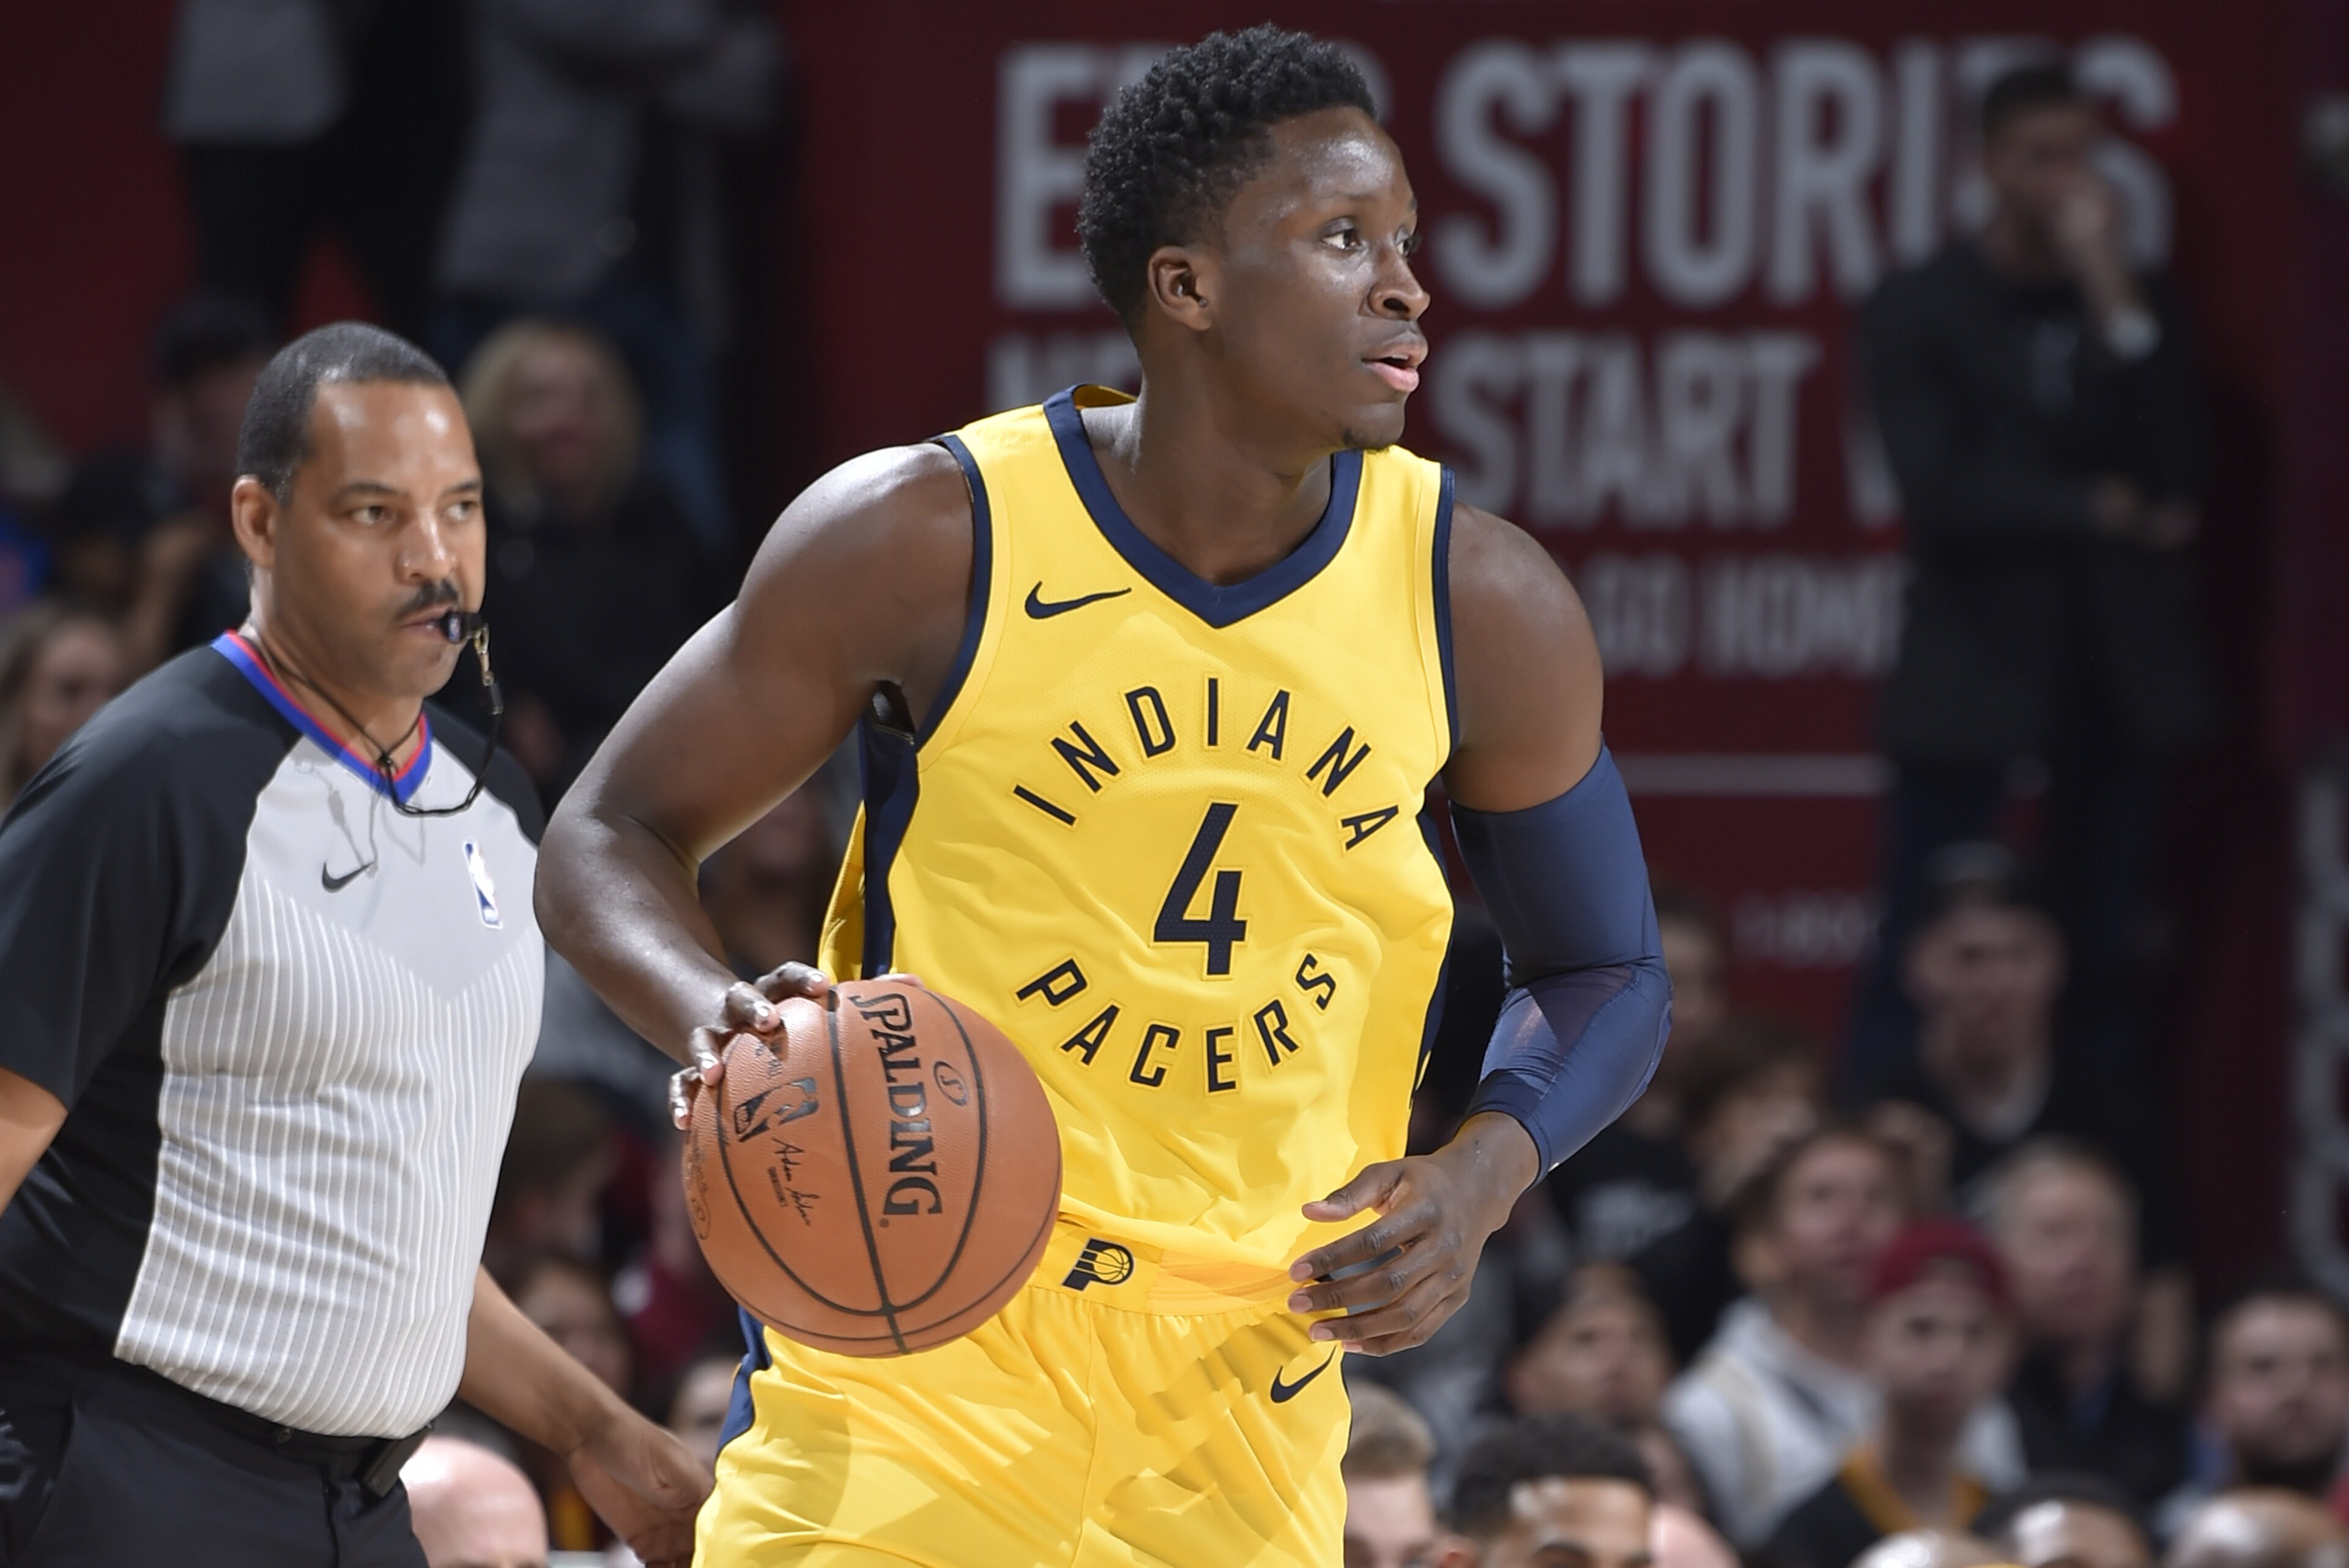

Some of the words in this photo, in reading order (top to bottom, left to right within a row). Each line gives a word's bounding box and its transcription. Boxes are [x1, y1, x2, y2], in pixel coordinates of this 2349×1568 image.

[1430, 330, 1820, 530] START
[1014, 678, 1399, 849] INDIANA
[1154, 803, 1246, 975] 4
[848, 993, 943, 1216] SPALDING
[1016, 953, 1337, 1093] PACERS
